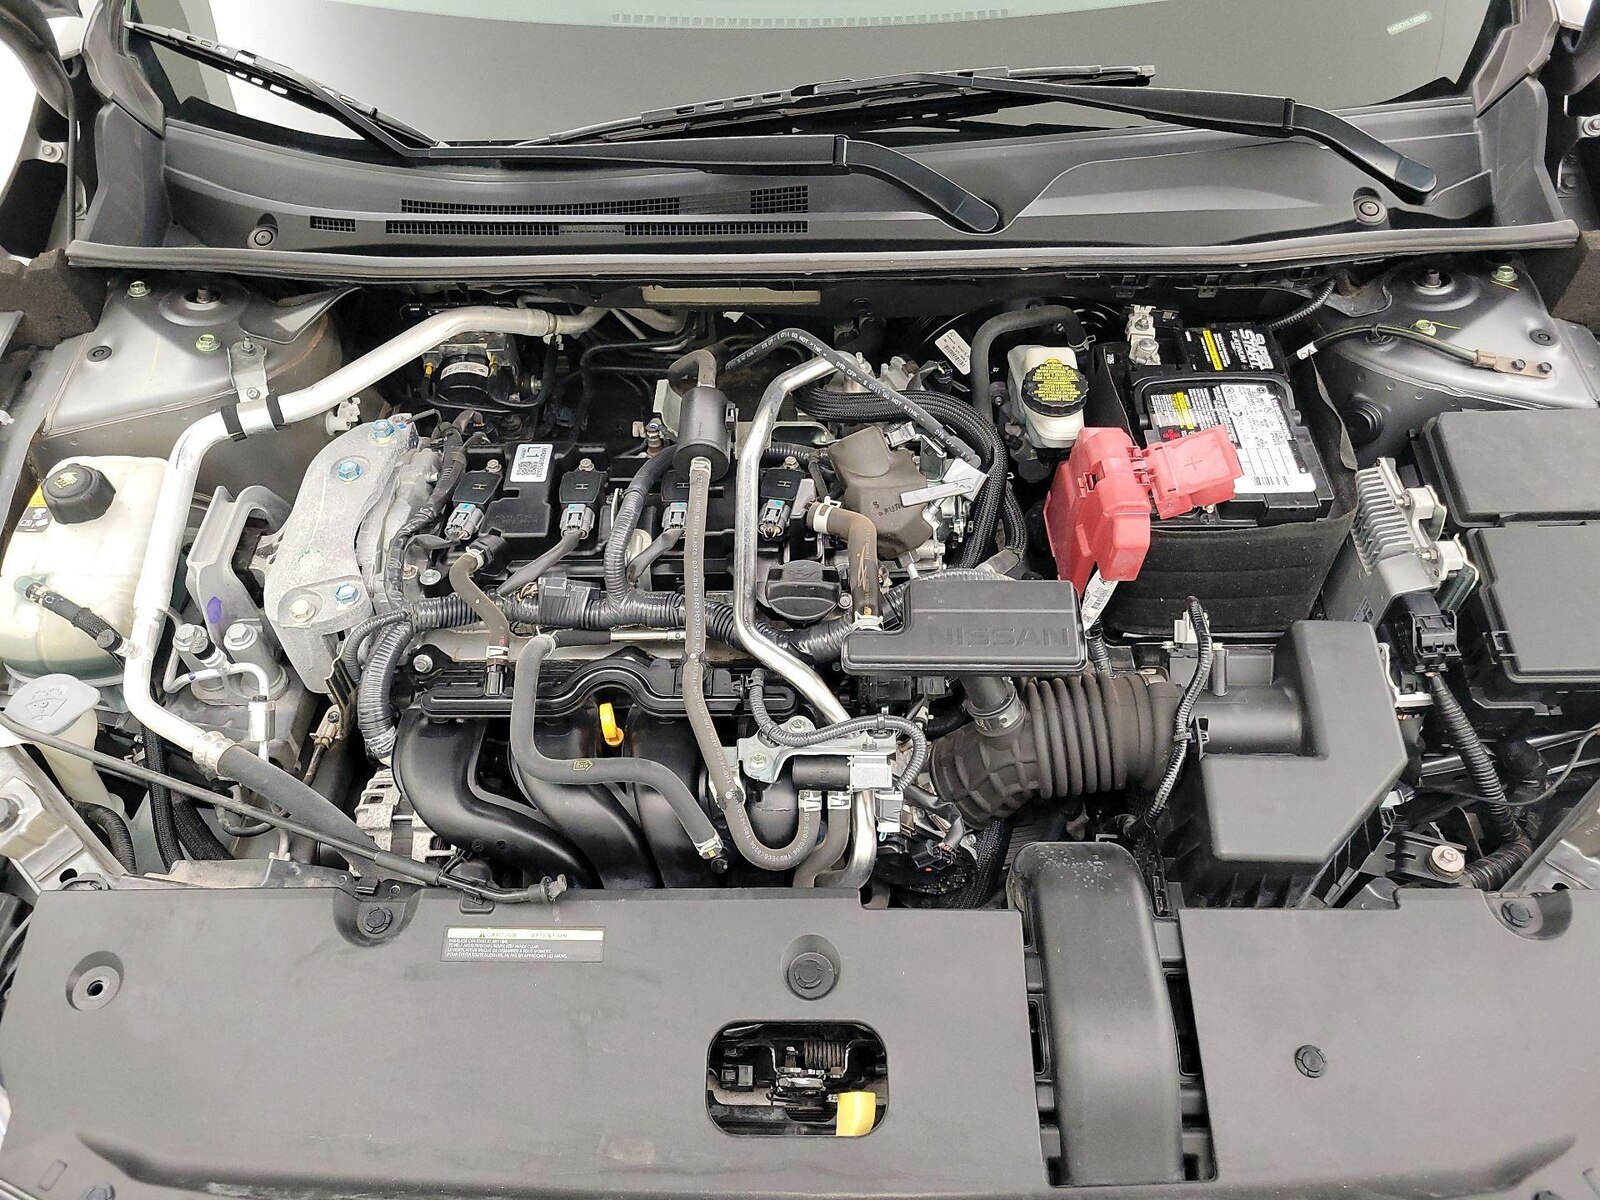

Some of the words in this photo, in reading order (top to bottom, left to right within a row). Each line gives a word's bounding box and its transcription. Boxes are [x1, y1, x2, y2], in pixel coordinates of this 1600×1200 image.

[1229, 330, 1250, 364] PLATINUM
[1241, 329, 1261, 369] START
[927, 627, 1070, 648] NISSAN
